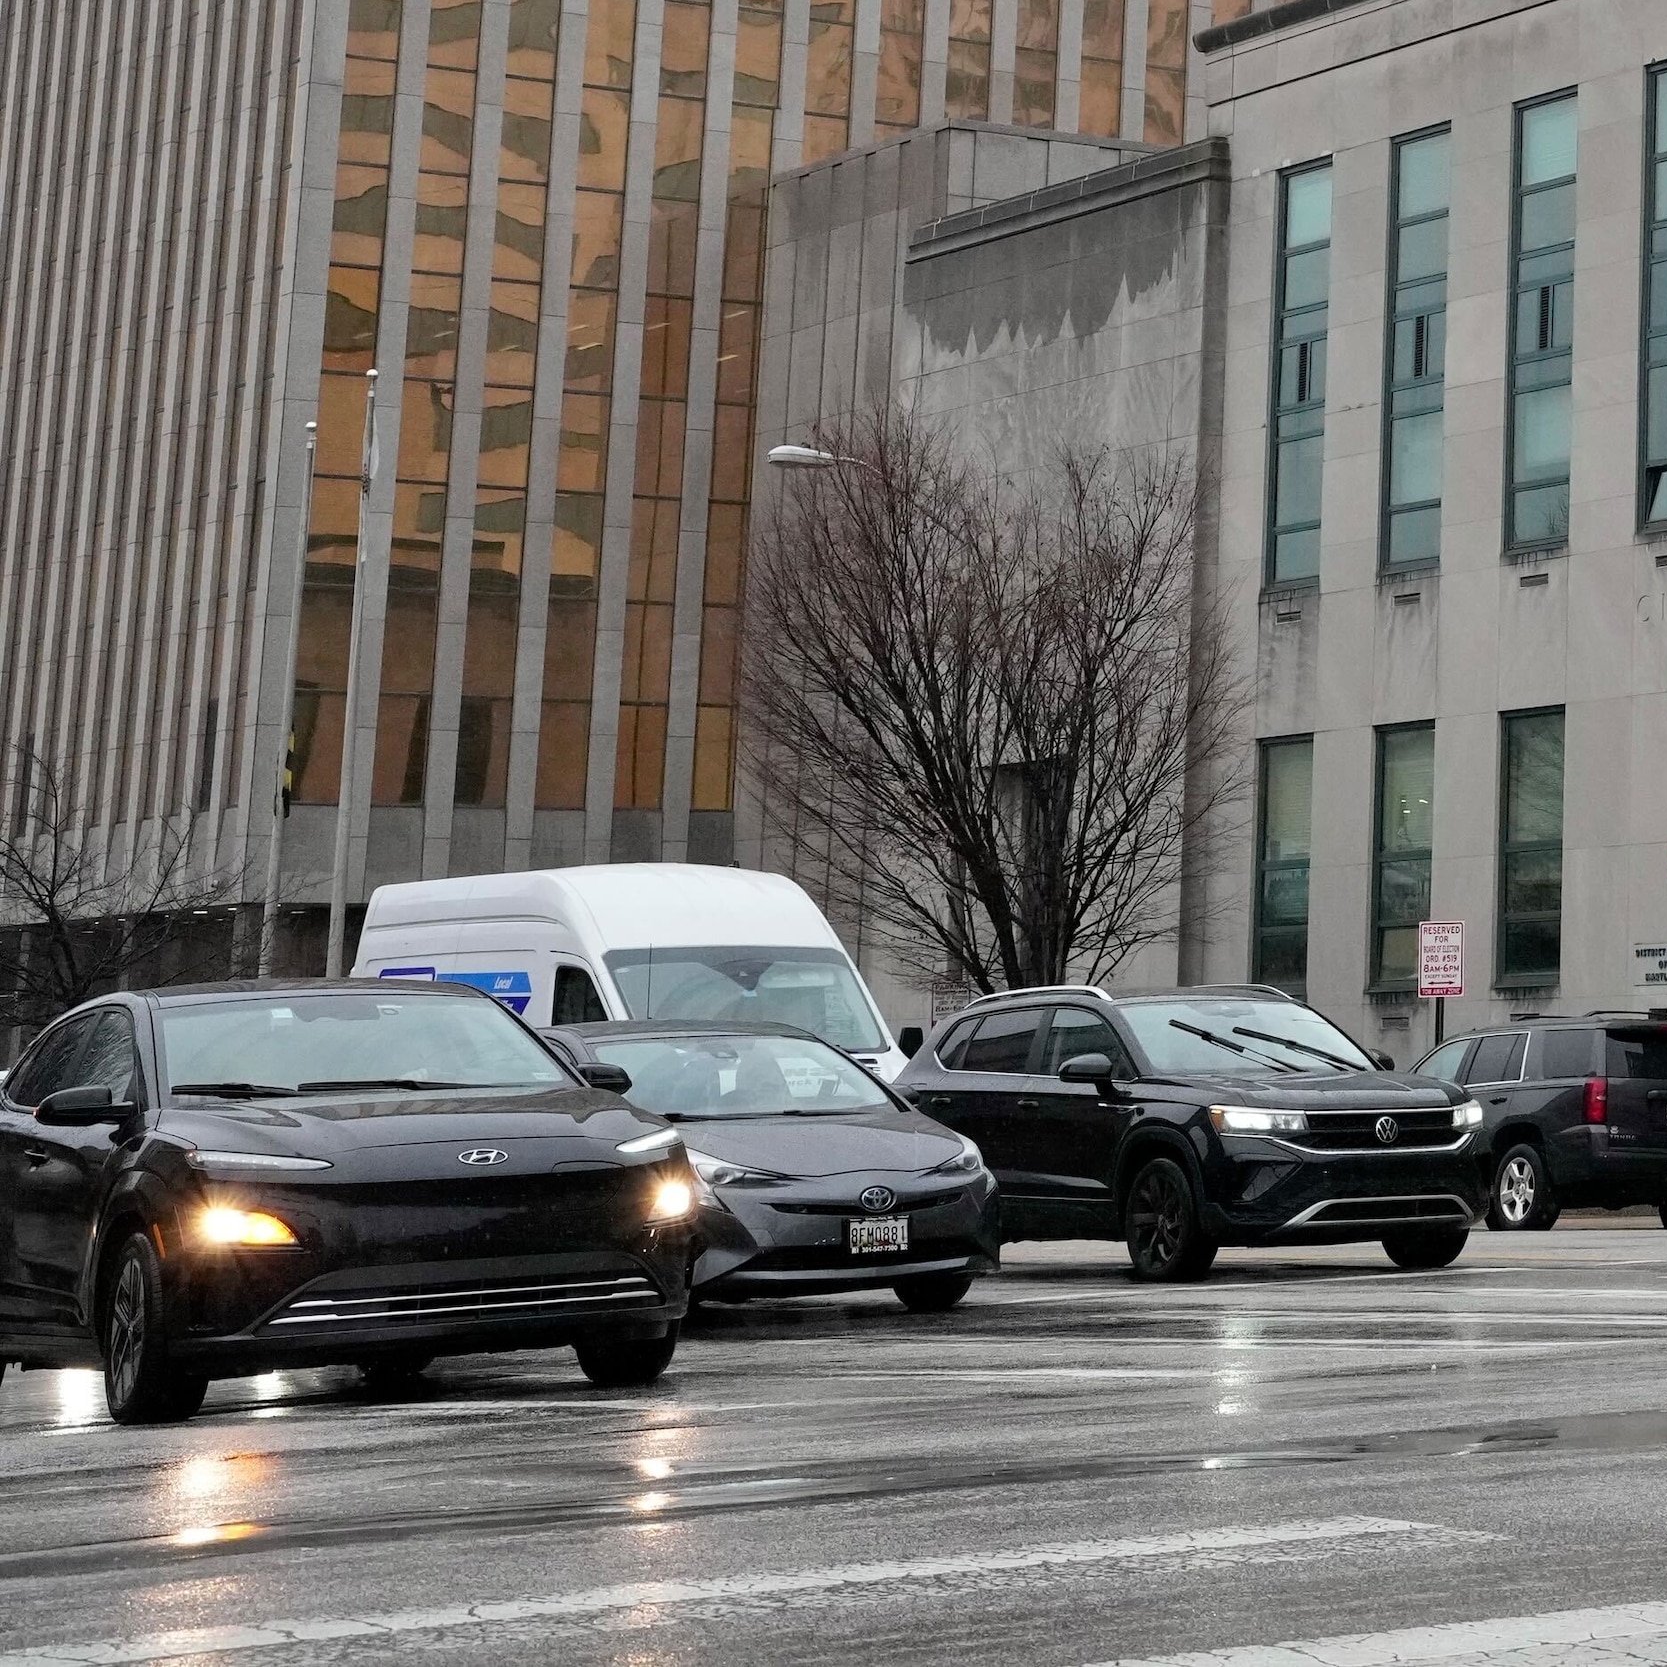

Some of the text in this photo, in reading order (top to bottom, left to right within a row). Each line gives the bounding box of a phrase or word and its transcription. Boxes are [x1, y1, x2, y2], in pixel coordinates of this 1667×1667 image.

[1423, 926, 1460, 934] RESERVED
[1434, 935, 1449, 943] FOR
[1635, 948, 1667, 958] DISTRICT
[1423, 964, 1459, 973] 8AM-6PM
[493, 976, 514, 990] Local
